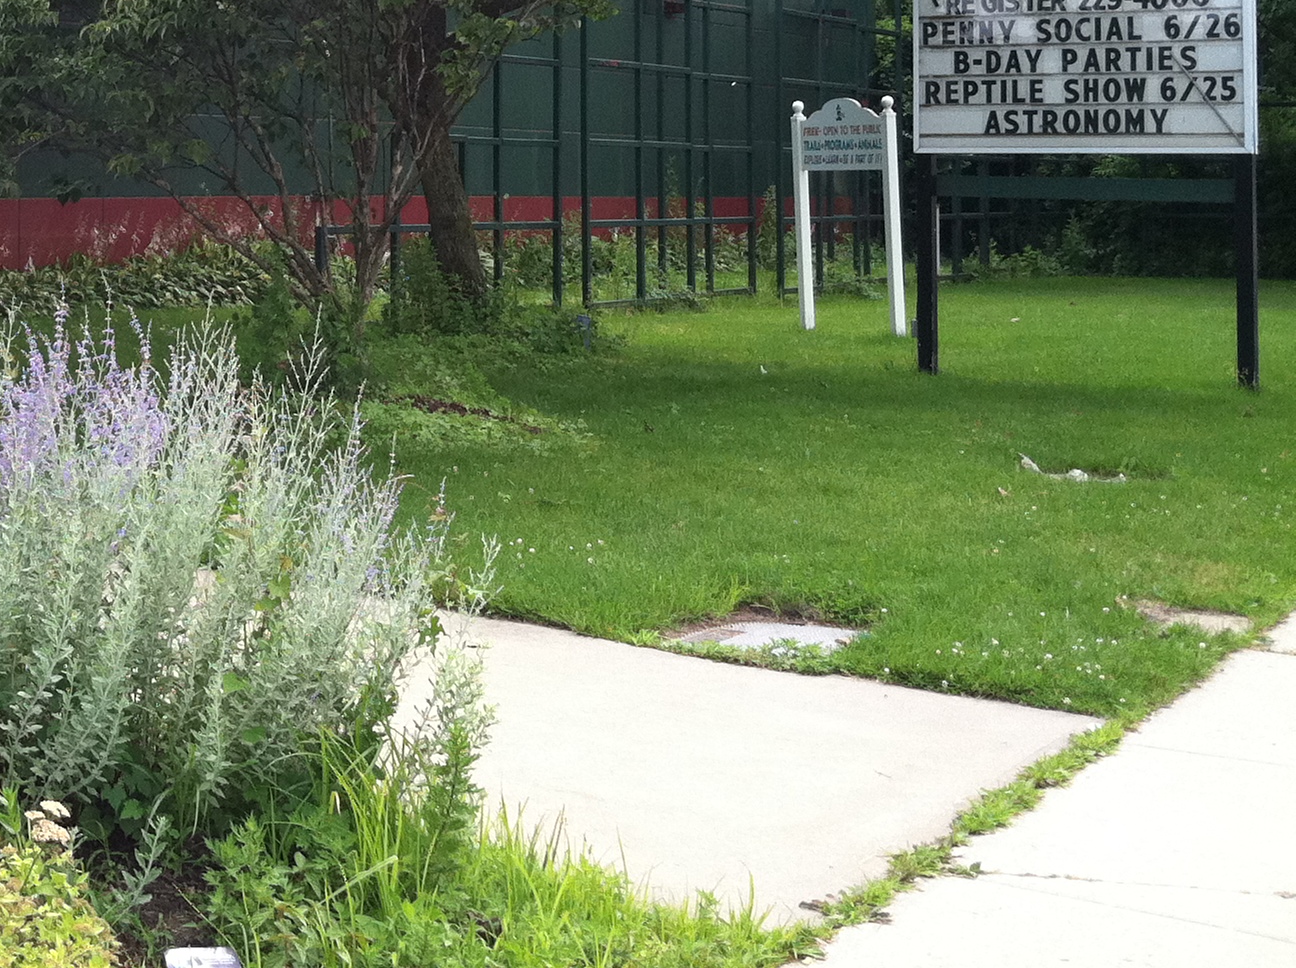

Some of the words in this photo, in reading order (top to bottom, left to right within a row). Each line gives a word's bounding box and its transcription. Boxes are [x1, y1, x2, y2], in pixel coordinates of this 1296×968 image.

[922, 19, 1016, 45] PENNY
[1035, 16, 1142, 43] SOCIAL
[1164, 13, 1241, 40] 6/26
[953, 49, 1042, 74] B-DAY
[1061, 45, 1197, 73] PARTIES
[925, 79, 1044, 104] REPTILE
[1064, 77, 1147, 103] SHOW
[1160, 76, 1237, 101] 6/25
[840, 125, 849, 135] TO
[850, 124, 861, 134] THE
[984, 108, 1169, 134] ASTRONOMY
